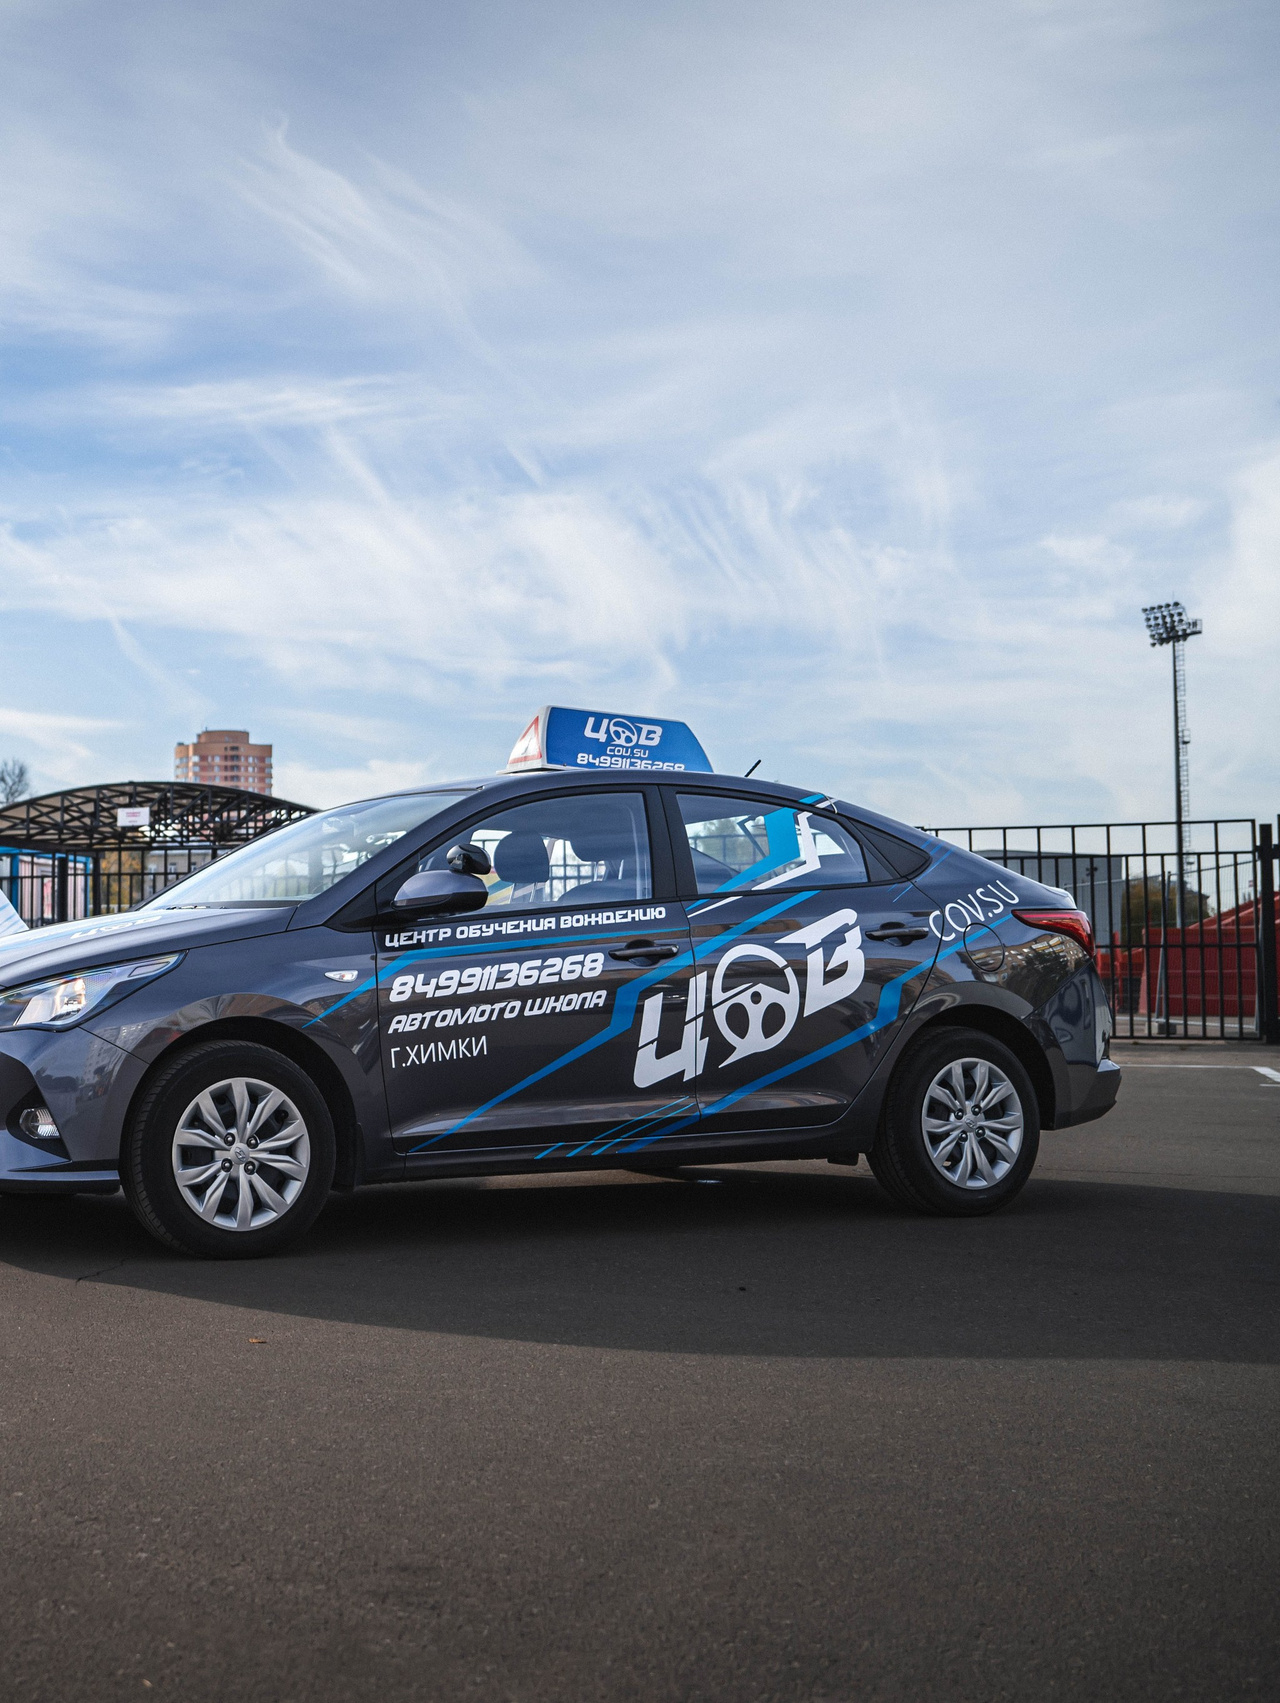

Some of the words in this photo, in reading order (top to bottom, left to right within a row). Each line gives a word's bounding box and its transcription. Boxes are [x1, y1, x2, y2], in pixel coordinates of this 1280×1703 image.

[577, 753, 685, 771] 84991136268
[384, 927, 451, 948] ЦЕНТР
[456, 917, 556, 940] ОБУЧЕНИЯ
[560, 906, 666, 929] ВОЖДЕНИЮ
[928, 879, 1020, 942] COV.SU
[389, 952, 605, 1003] 84991136268
[388, 1000, 522, 1034] АВТОМОТО
[524, 989, 608, 1017] ШКОЛА
[390, 1035, 488, 1069] Г.ХИМКИ
